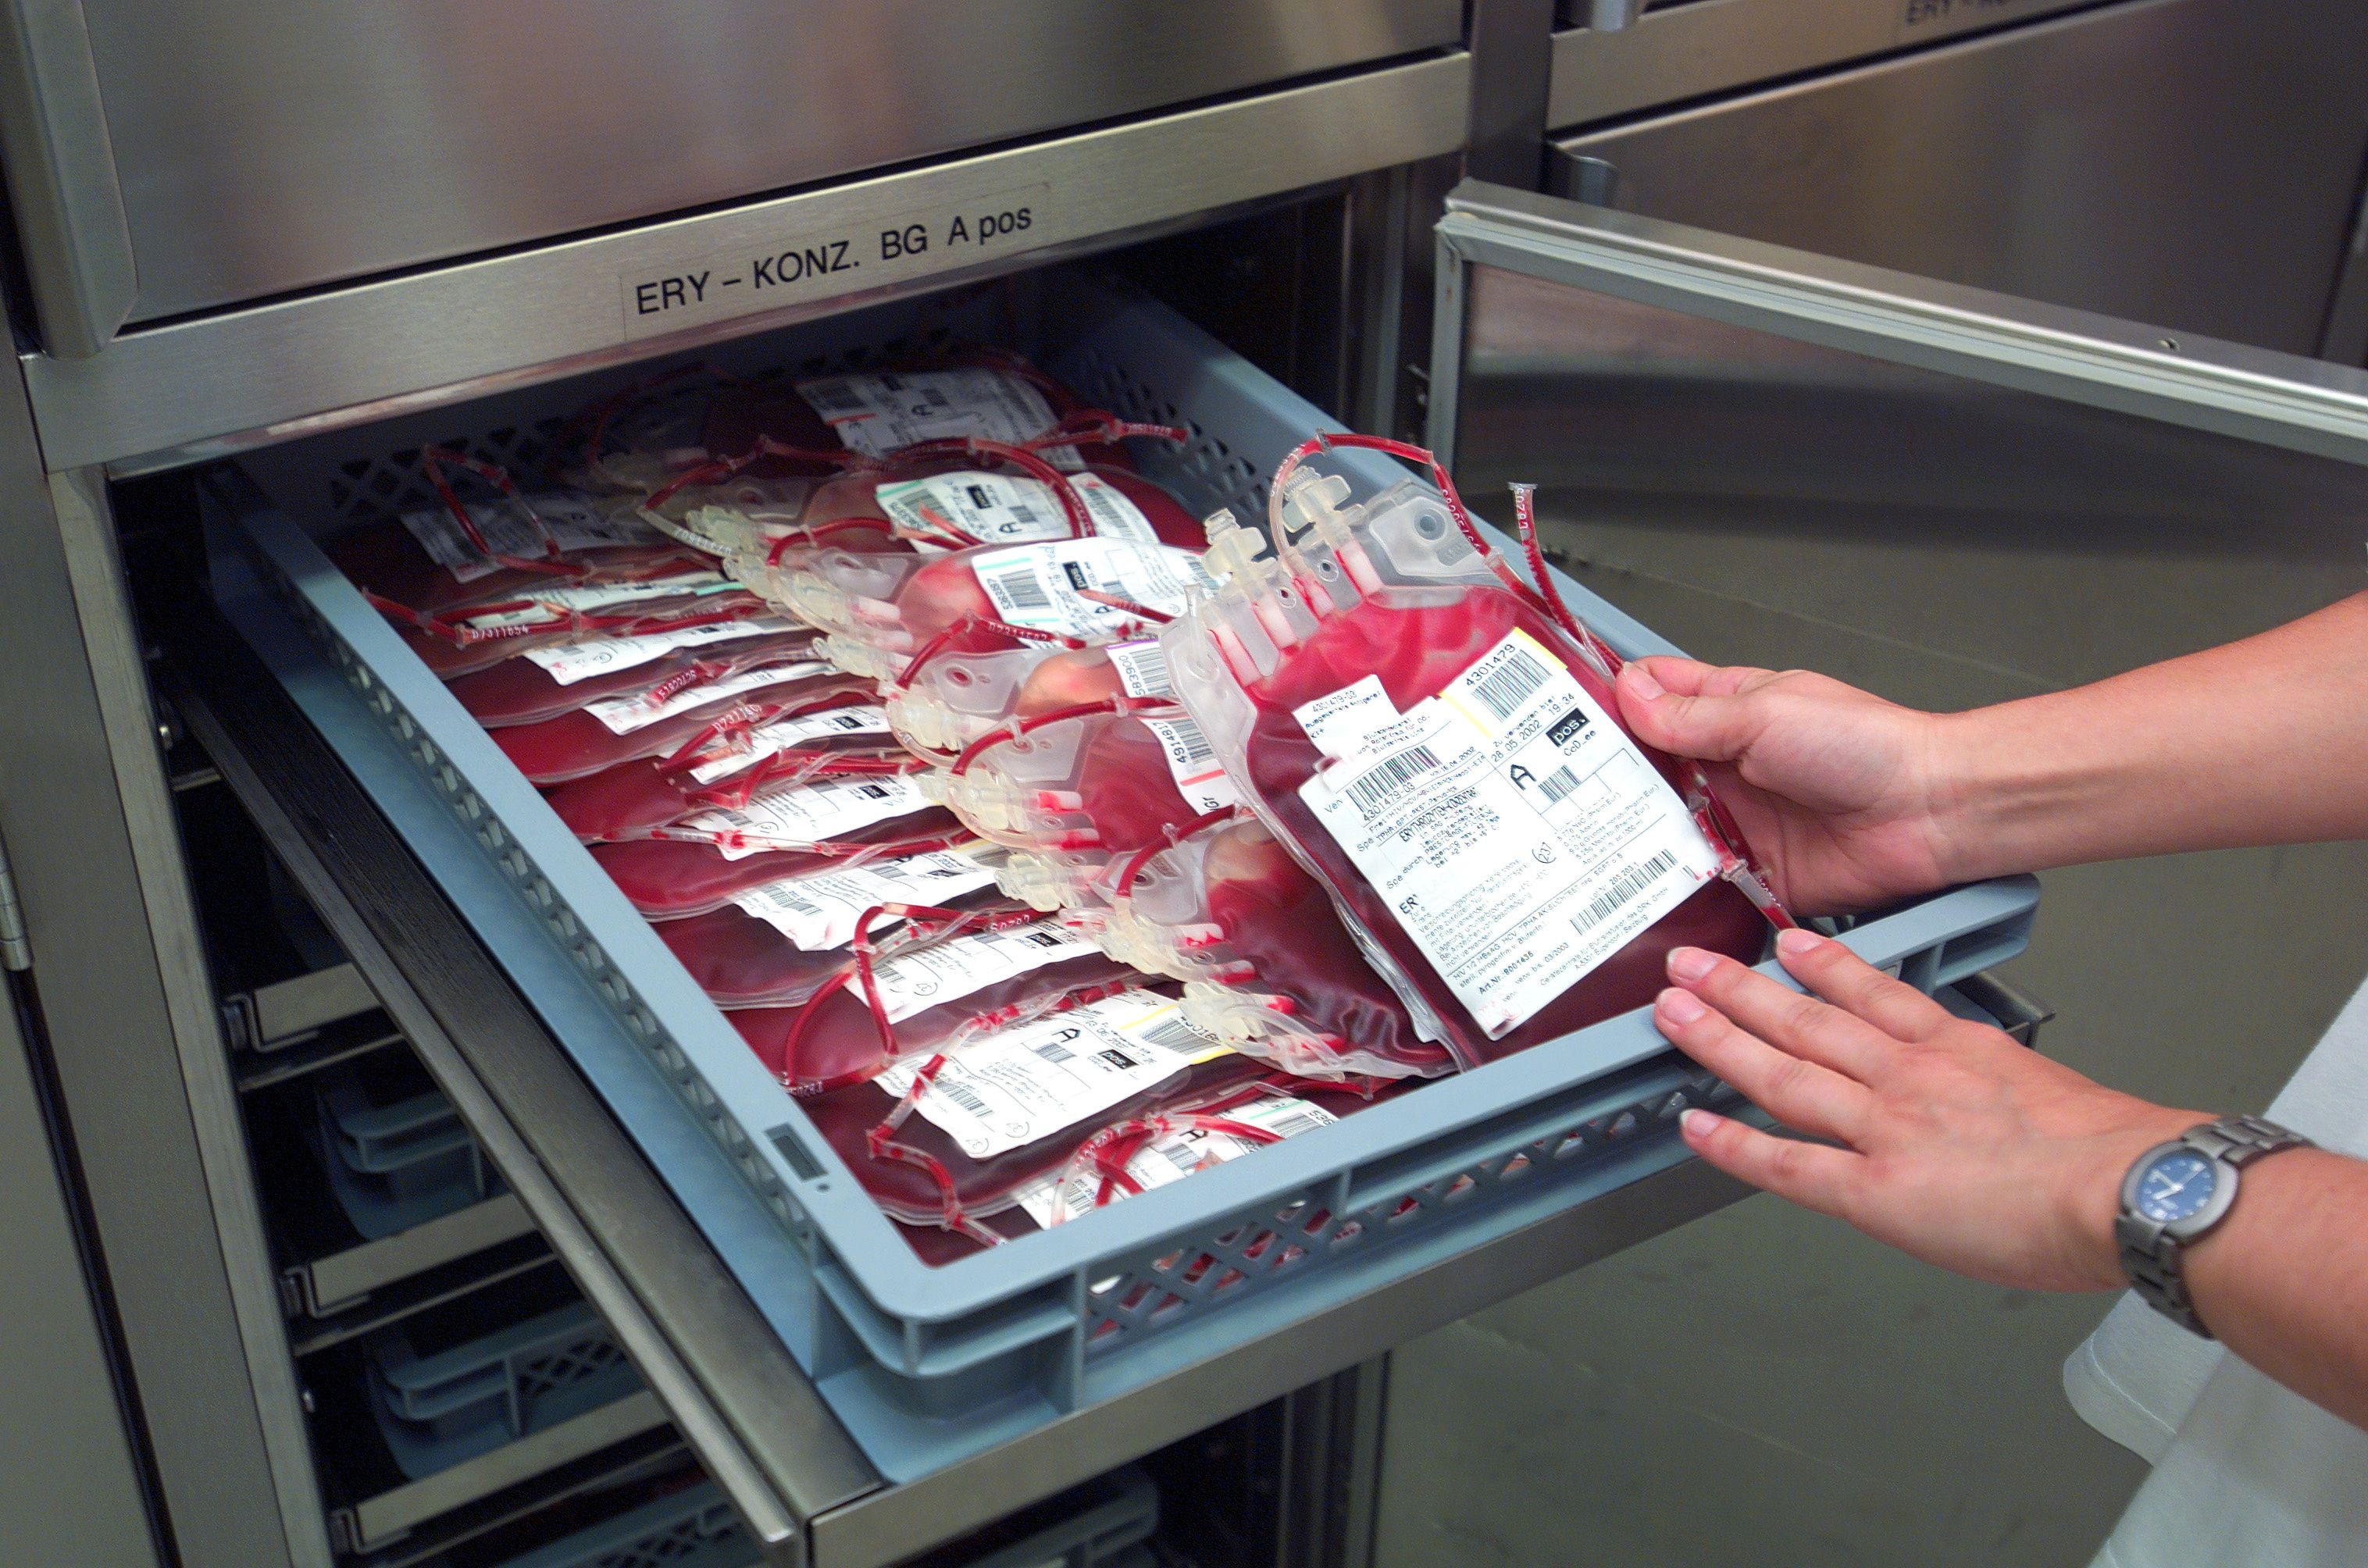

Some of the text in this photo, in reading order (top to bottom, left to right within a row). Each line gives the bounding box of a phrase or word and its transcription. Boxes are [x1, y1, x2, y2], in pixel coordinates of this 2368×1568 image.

[637, 272, 710, 315] ERY
[753, 241, 860, 289] KONZ.
[881, 225, 927, 260] BG
[947, 216, 969, 245] A
[979, 208, 1031, 244] pos
[999, 522, 1018, 533] A
[1464, 641, 1516, 688] 4301479
[1152, 722, 1187, 765] 4914817
[1551, 714, 1586, 746] pos.
[1510, 764, 1537, 791] A
[1052, 1028, 1081, 1044] A
